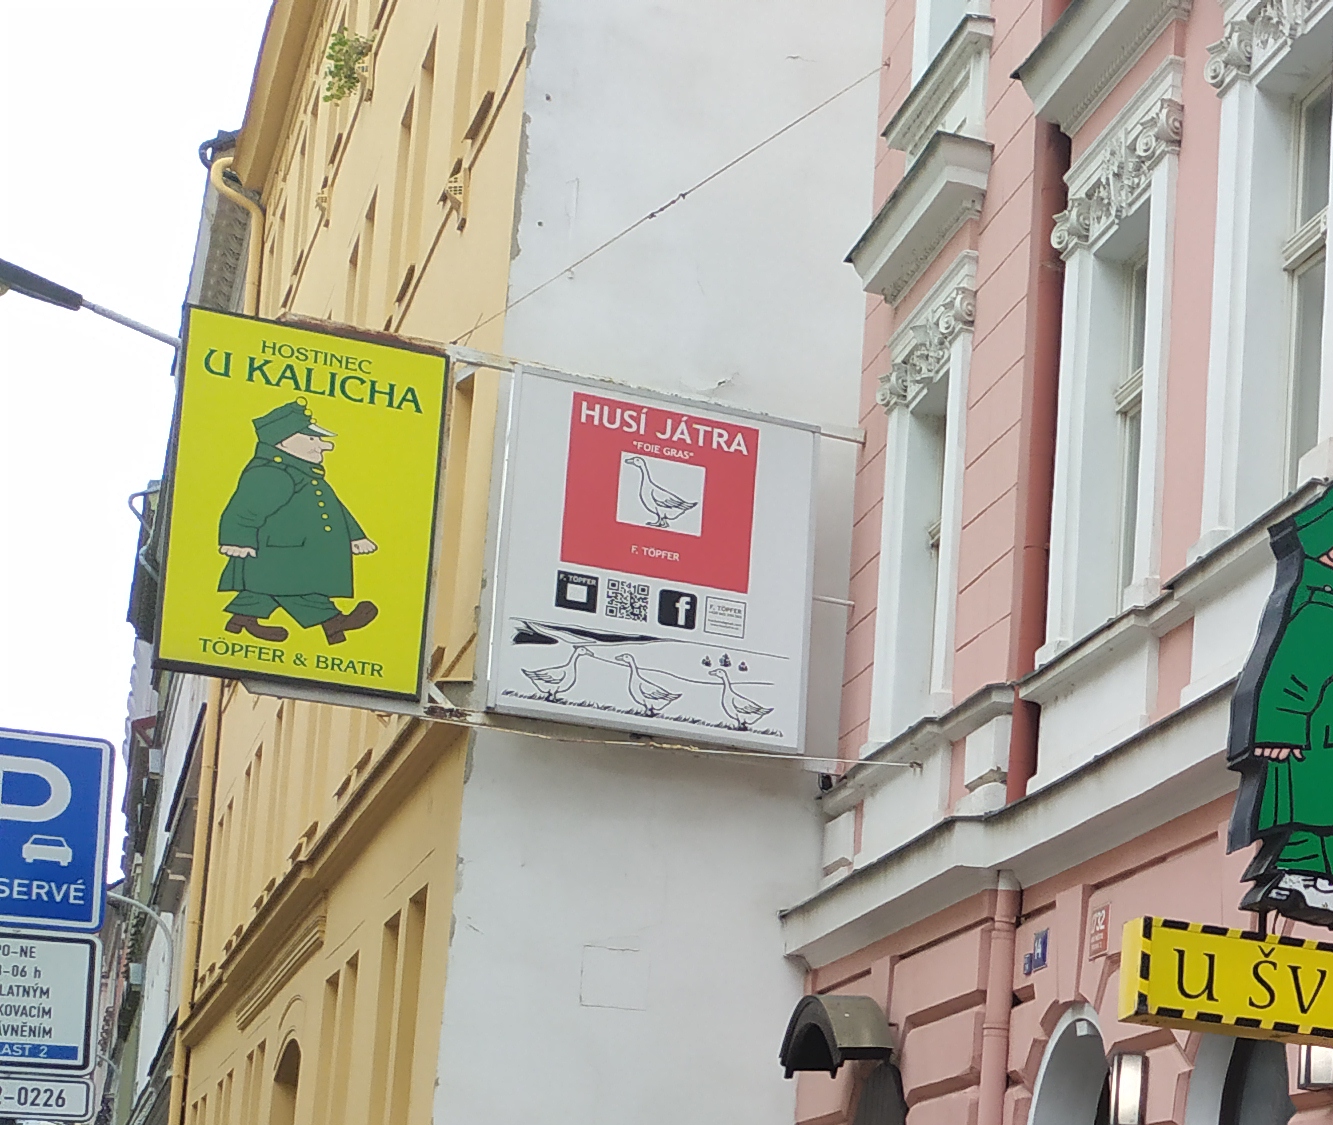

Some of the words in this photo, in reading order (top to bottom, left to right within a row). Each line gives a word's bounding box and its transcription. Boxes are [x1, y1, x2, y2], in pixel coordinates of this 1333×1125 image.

[261, 340, 372, 374] HOSTINEC
[204, 348, 232, 378] U
[246, 356, 423, 414] KALICHA
[580, 400, 648, 435] HUSÍ
[656, 417, 748, 456] JÁTRA
[631, 545, 639, 555] F.
[642, 546, 680, 561] TÖPFER
[199, 637, 285, 663] TÖPFER
[293, 653, 308, 667] &
[315, 655, 384, 678] BRATR
[0, 944, 36, 958] O-NE
[0, 964, 27, 977] -06
[34, 966, 41, 978] h
[1173, 947, 1219, 1003] U
[0, 1044, 32, 1056] AST
[39, 1045, 48, 1058] 2
[0, 1086, 66, 1108] -0226
